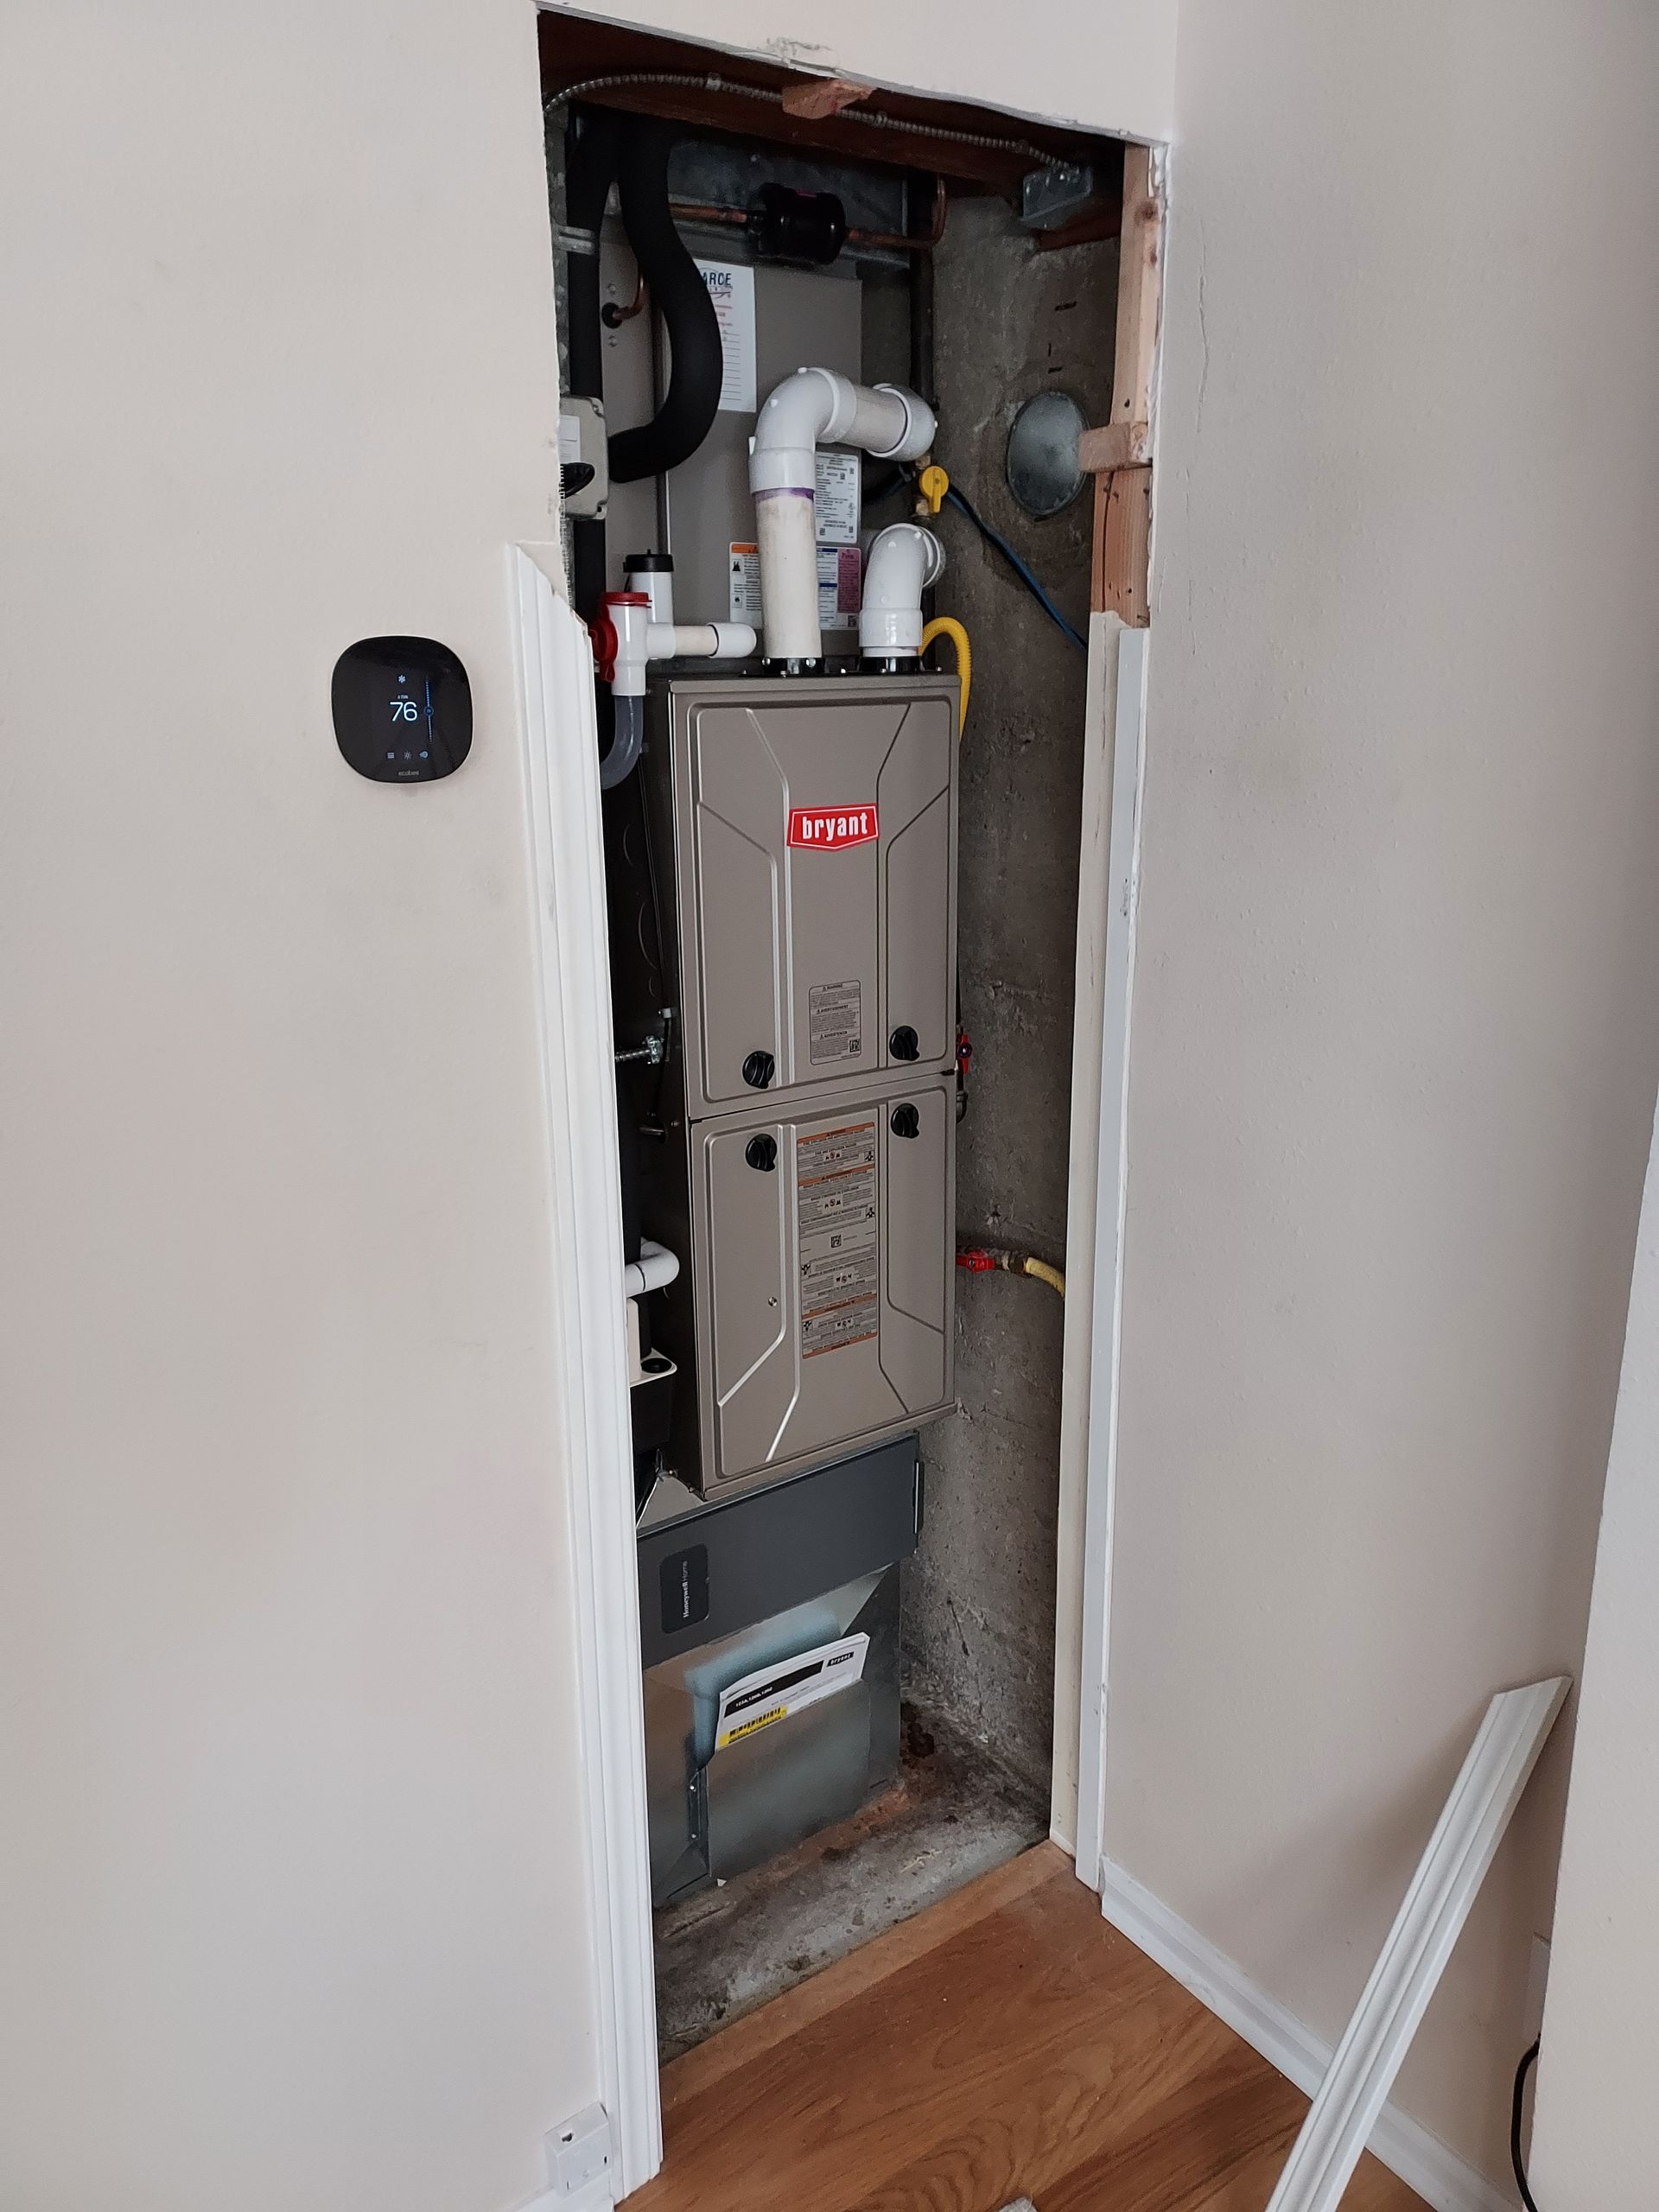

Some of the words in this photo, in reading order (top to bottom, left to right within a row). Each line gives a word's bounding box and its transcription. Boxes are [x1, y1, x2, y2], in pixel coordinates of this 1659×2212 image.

[390, 702, 417, 721] 76
[802, 812, 868, 842] bryant
[682, 1581, 690, 1618] Honeywell
